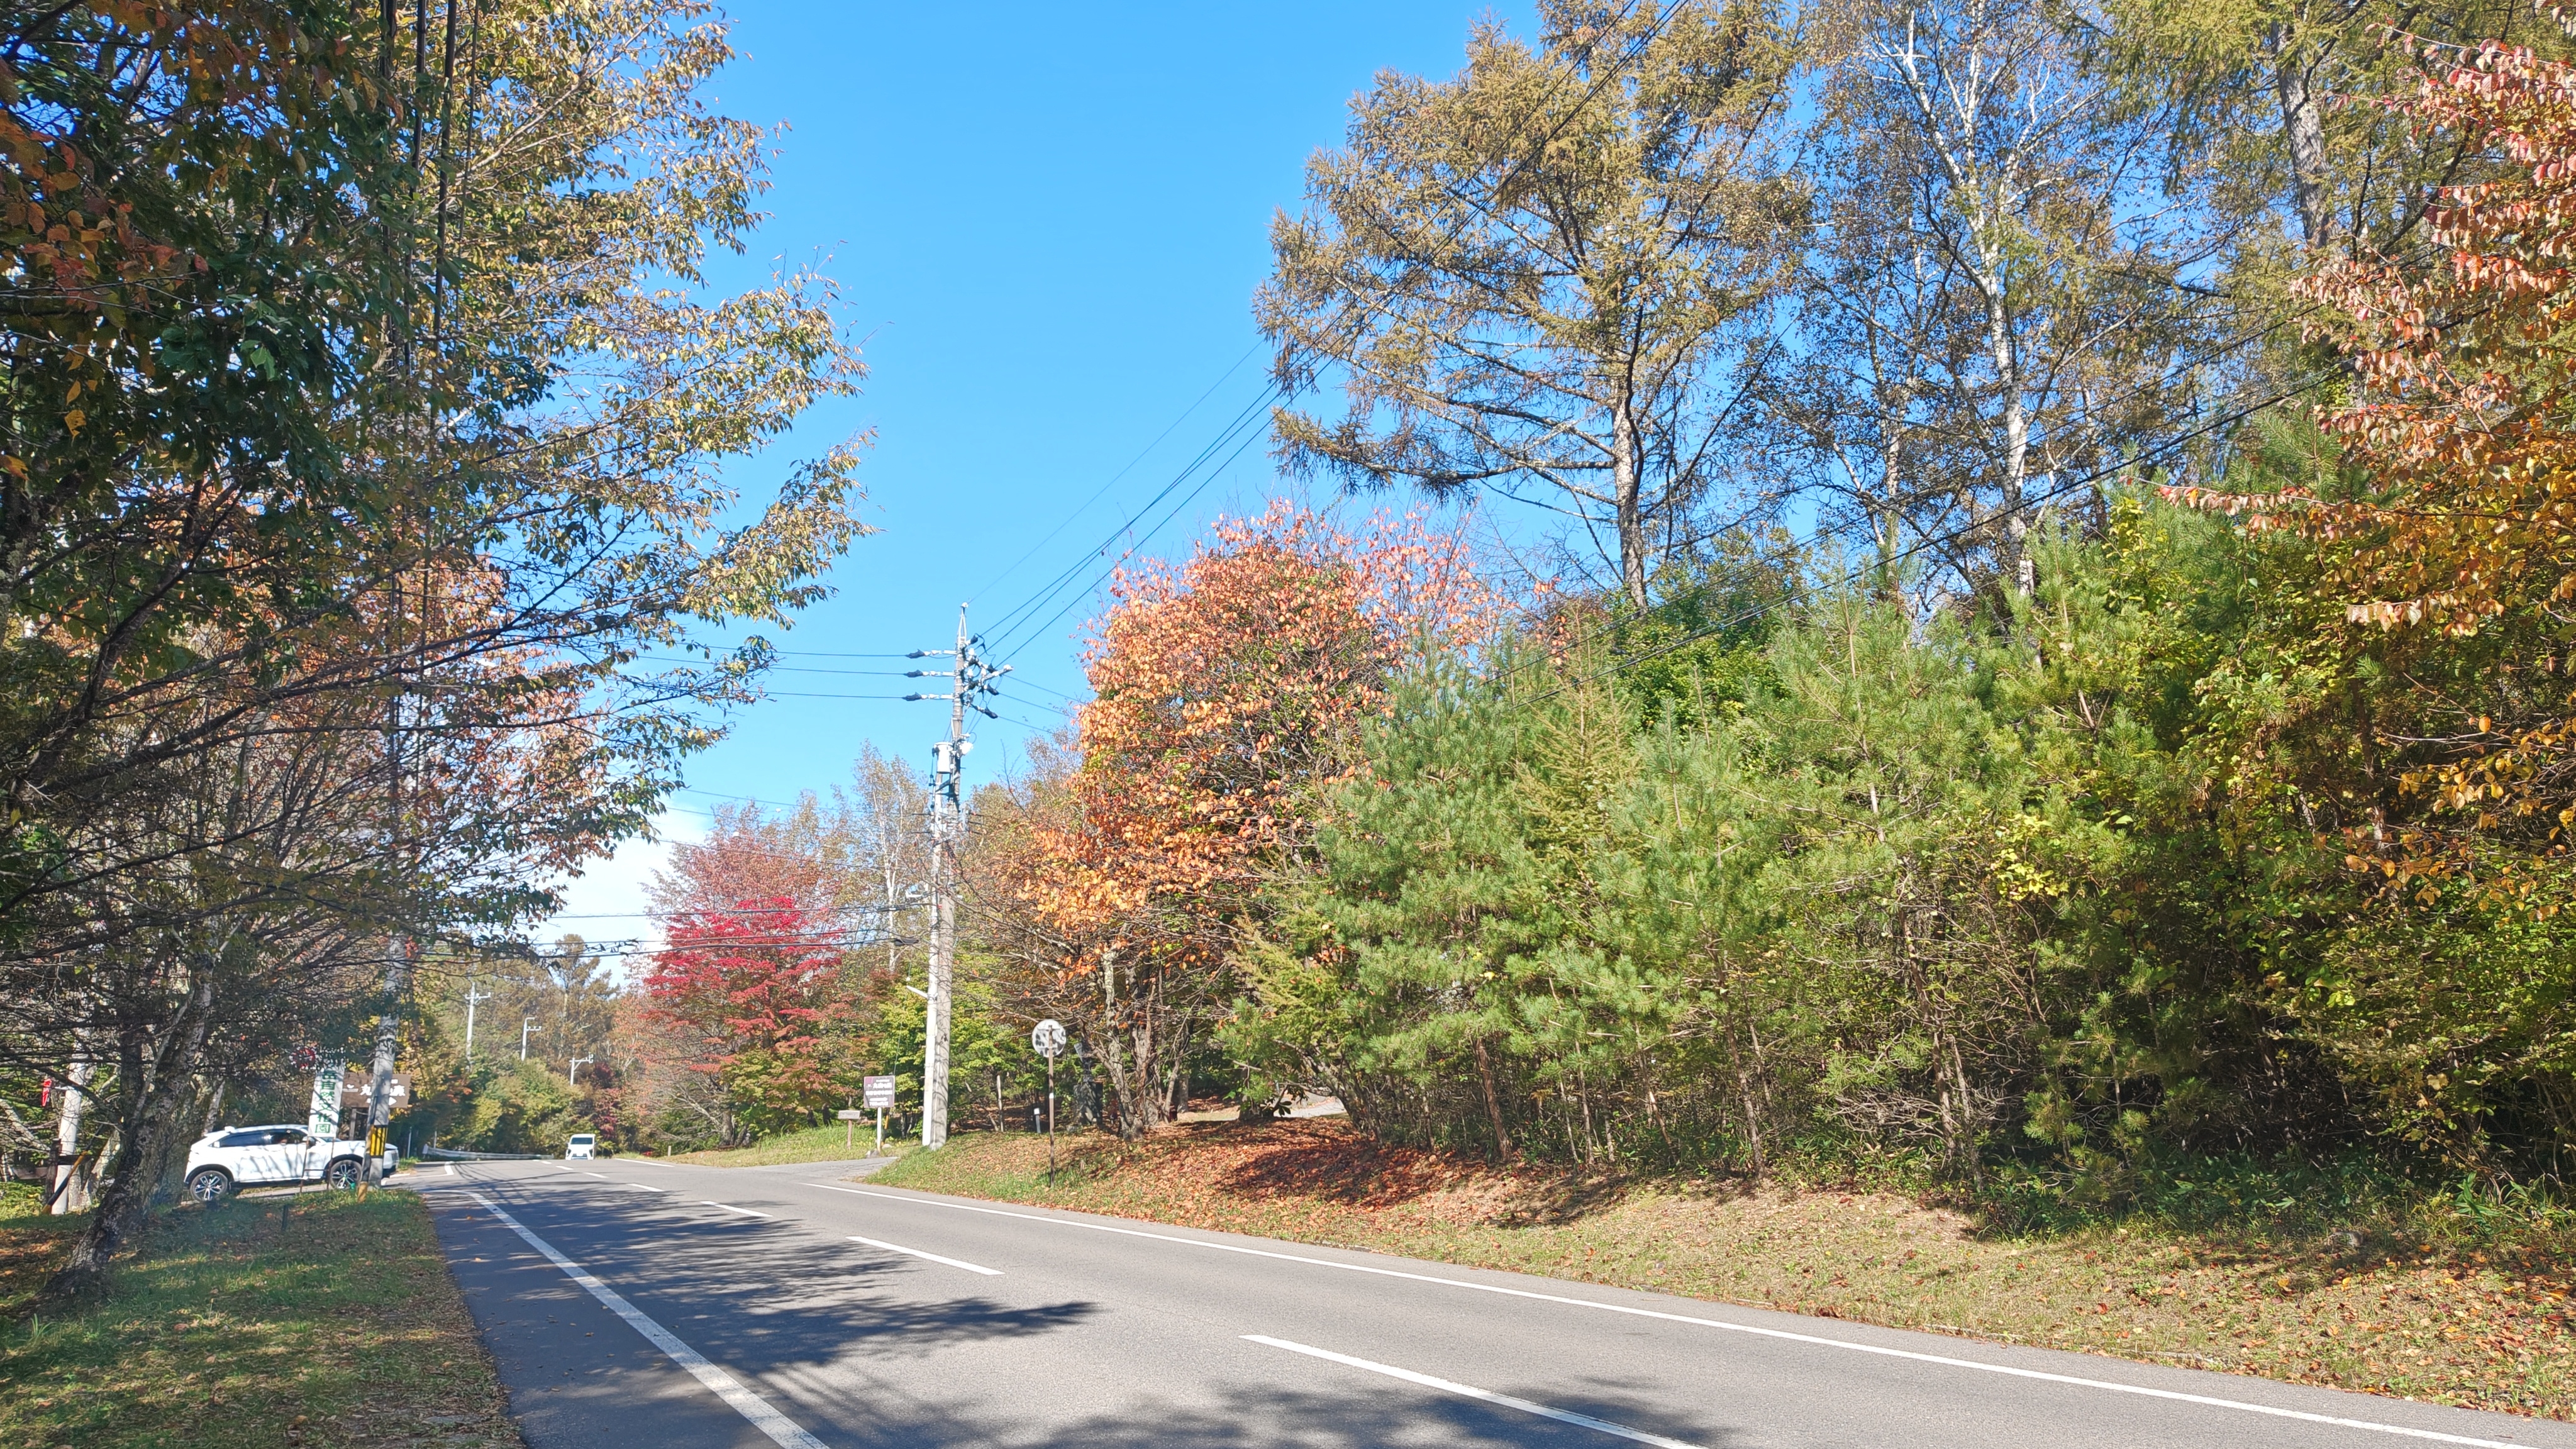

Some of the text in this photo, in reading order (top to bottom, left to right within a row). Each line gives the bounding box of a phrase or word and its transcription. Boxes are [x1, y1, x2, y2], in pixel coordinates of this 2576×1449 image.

[315, 1063, 336, 1133] 岳自然文化園
